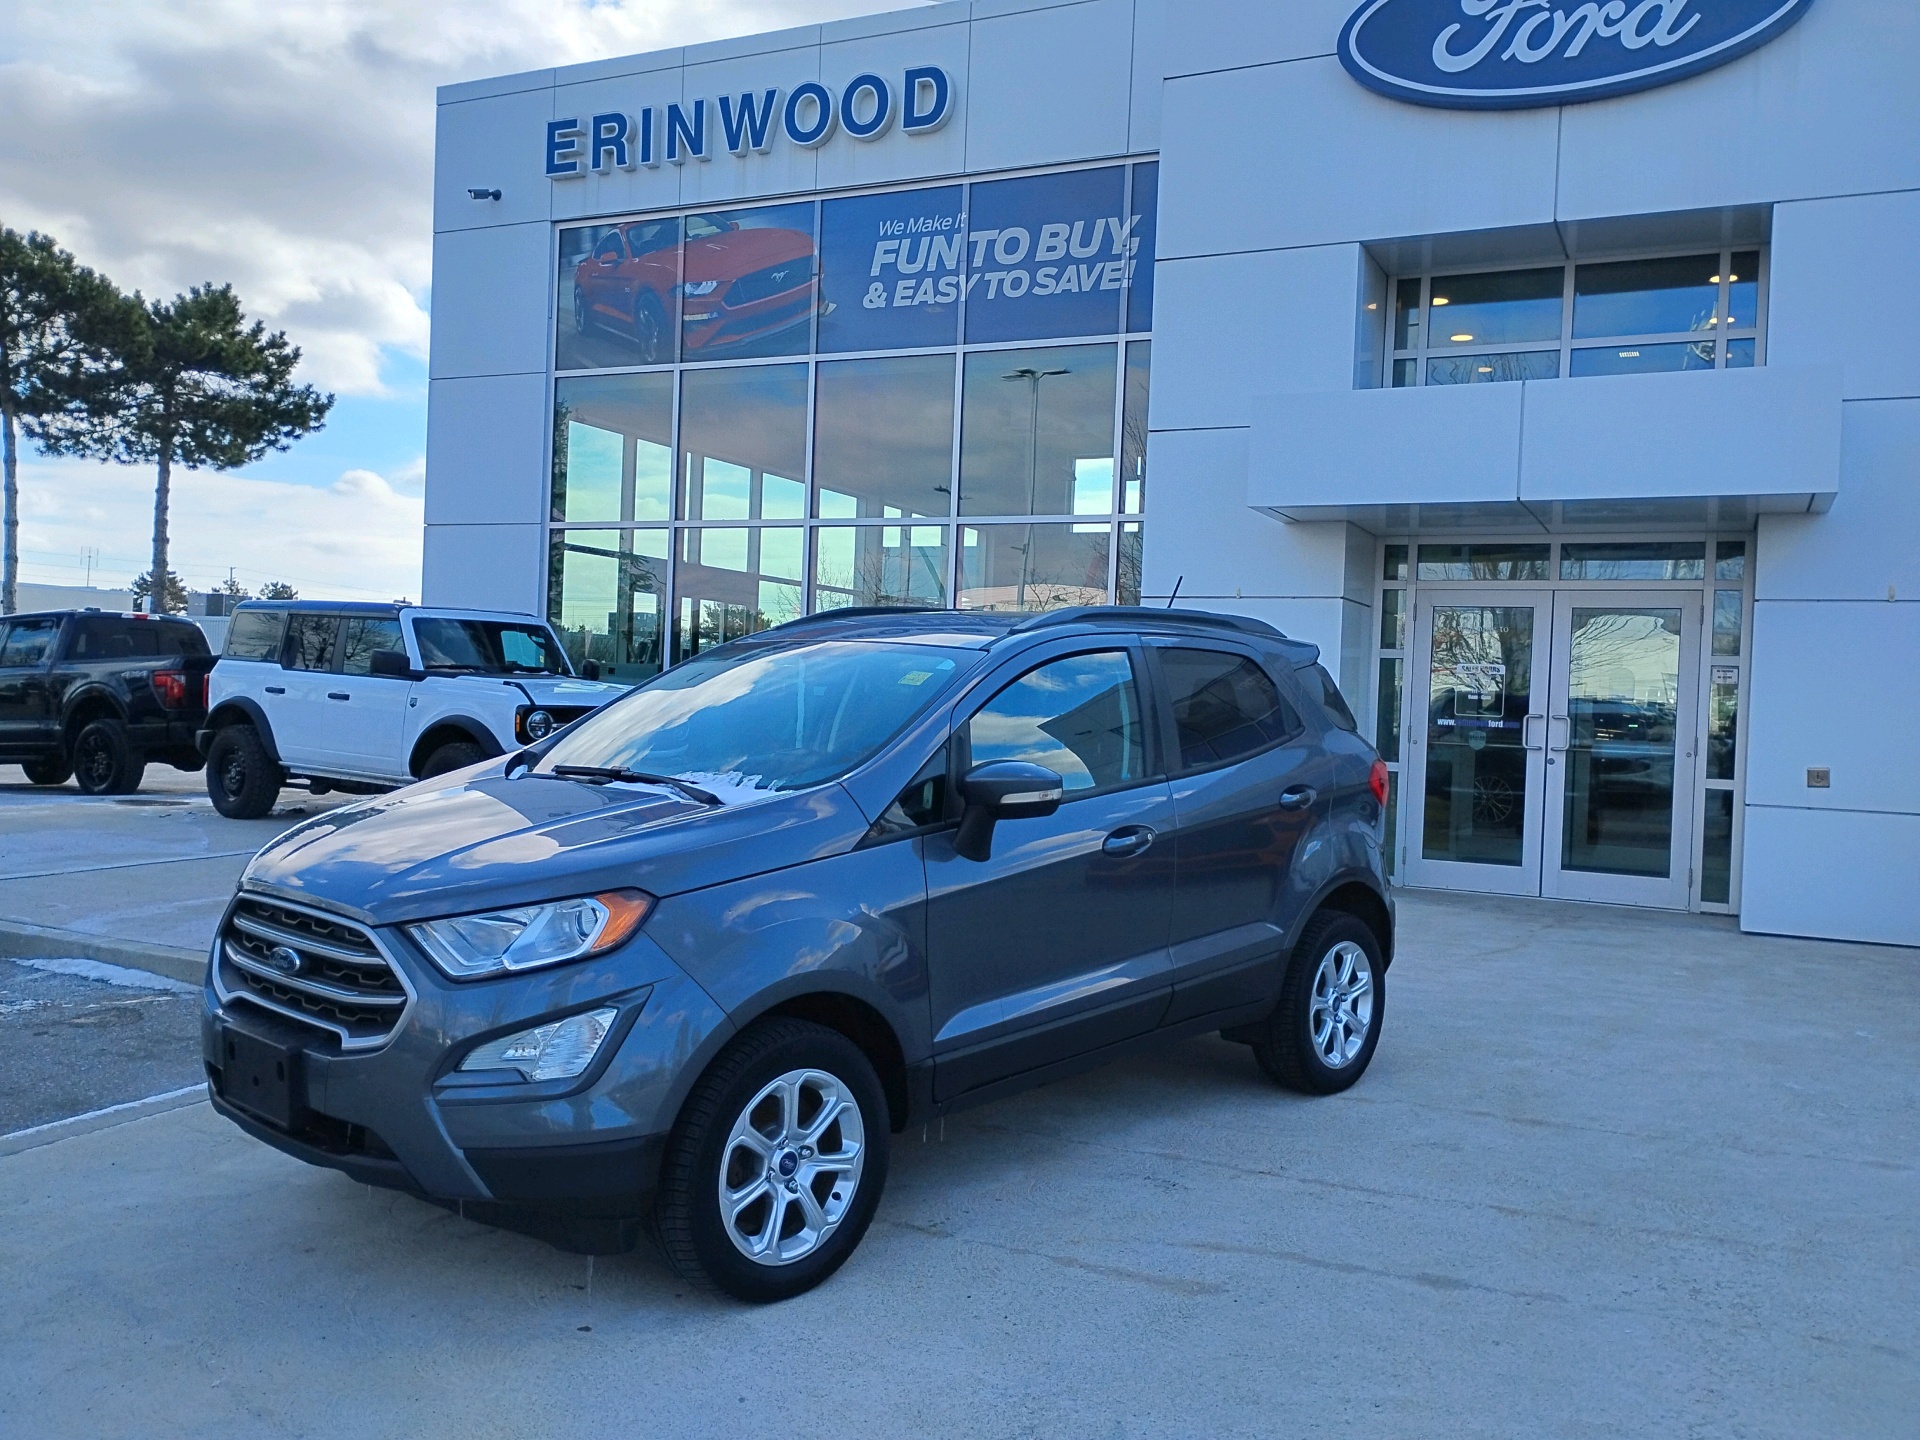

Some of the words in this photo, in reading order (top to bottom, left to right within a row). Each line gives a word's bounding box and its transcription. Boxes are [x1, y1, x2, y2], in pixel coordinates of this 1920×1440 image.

[545, 65, 952, 178] ERINWOOD
[870, 233, 961, 276] FUN
[968, 227, 1031, 268] TO
[1035, 214, 1142, 262] BUY,
[879, 220, 904, 236] We
[907, 214, 951, 234] Make
[955, 212, 967, 228] It
[862, 281, 888, 309] &
[892, 273, 981, 307] EASY
[983, 269, 1030, 300] TO
[1032, 259, 1137, 296] SAVE!
